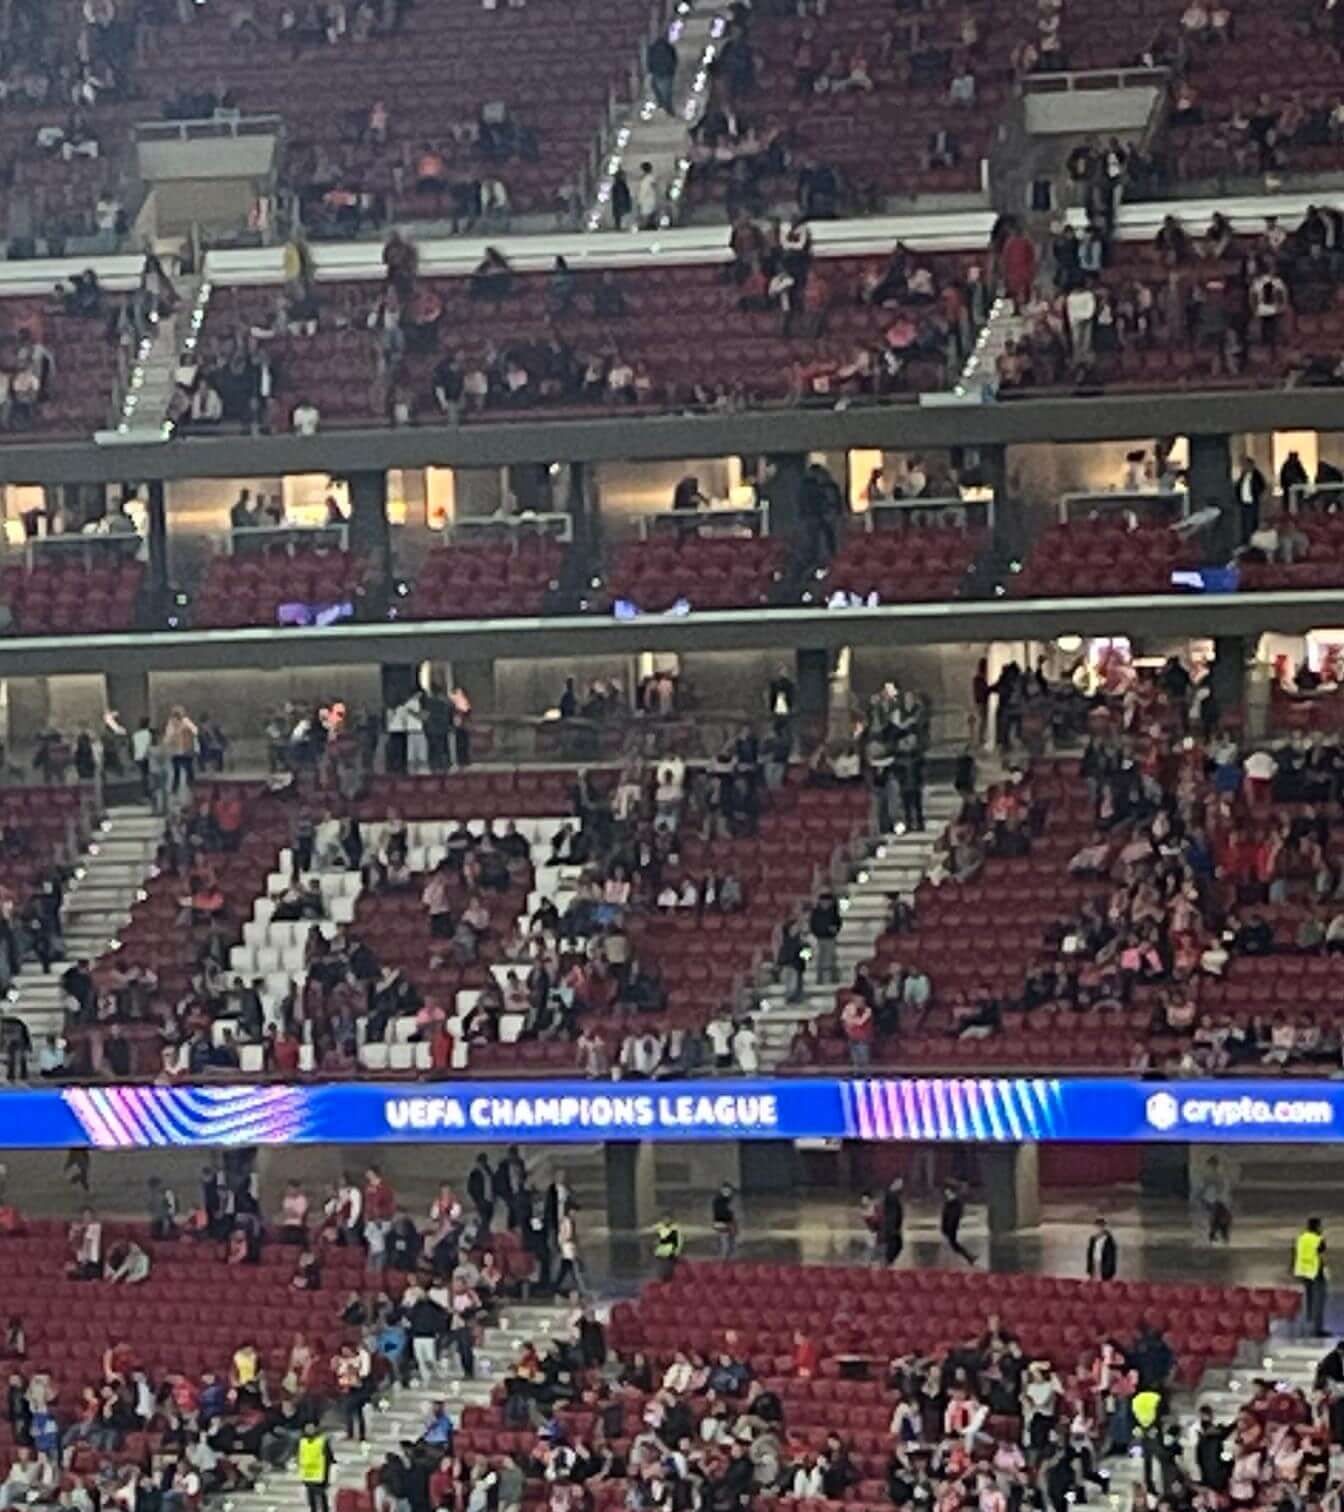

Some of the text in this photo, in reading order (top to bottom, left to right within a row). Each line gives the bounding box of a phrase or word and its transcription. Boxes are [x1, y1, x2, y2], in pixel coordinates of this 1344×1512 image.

[385, 1095, 778, 1128] UEFA CHAMPIONS LEAGUE
[1182, 1096, 1334, 1127] crypto.com
